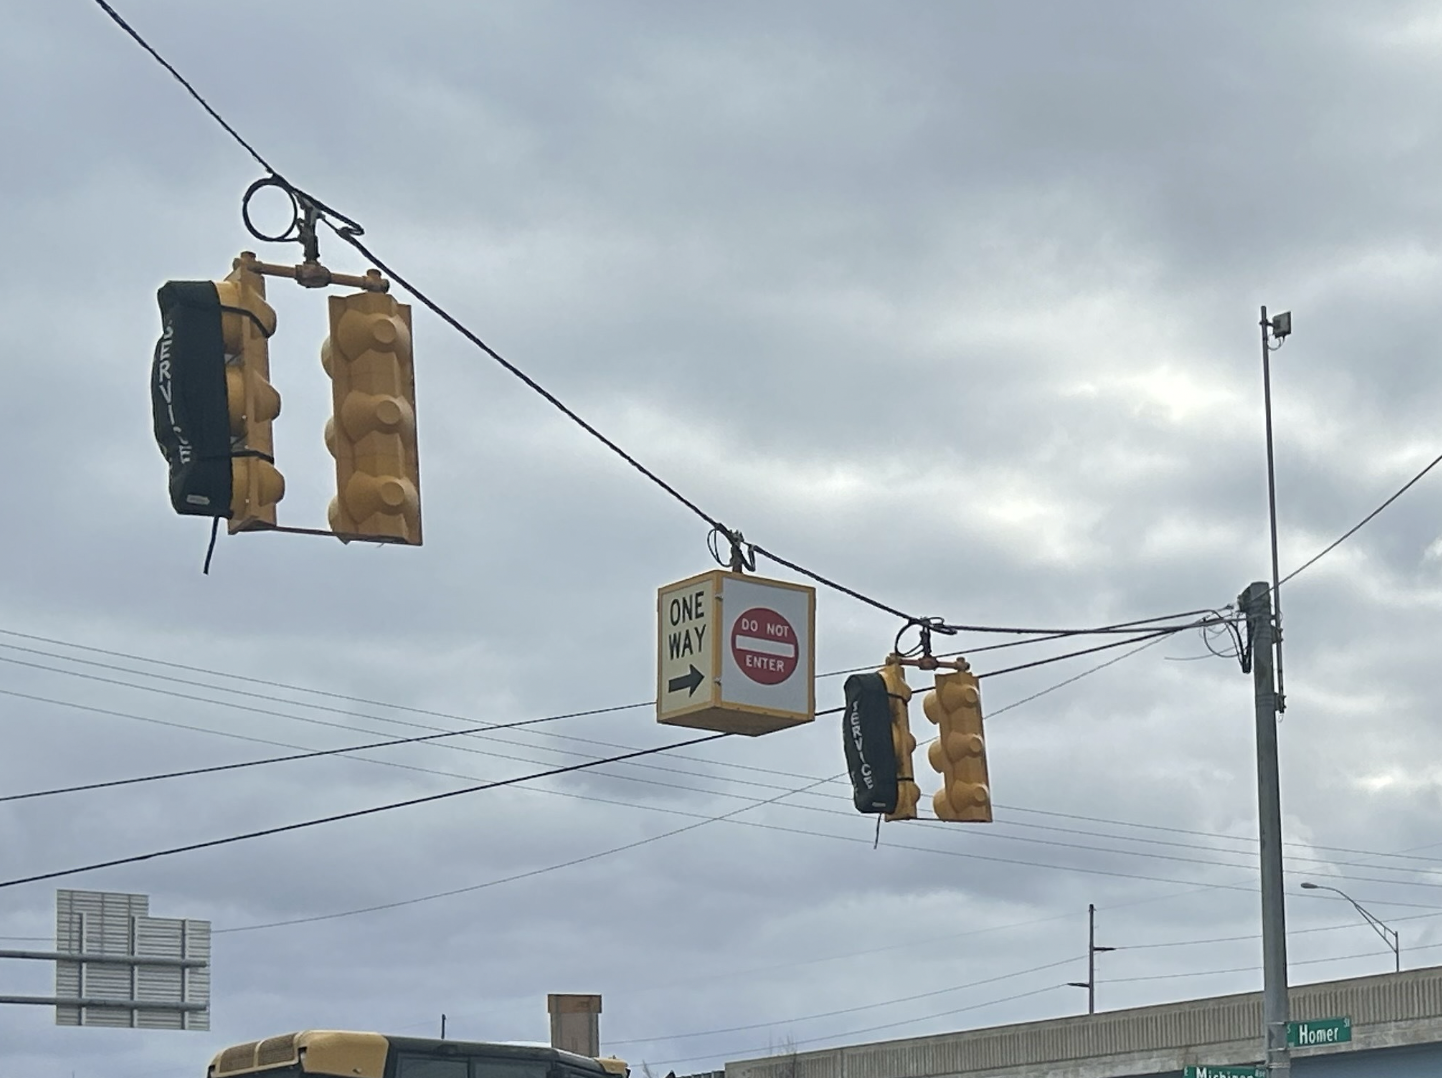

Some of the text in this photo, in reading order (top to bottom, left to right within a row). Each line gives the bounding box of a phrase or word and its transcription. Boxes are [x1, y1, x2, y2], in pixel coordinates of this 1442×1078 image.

[670, 590, 704, 626] ONE
[669, 624, 706, 660] WAY
[741, 618, 789, 638] DO NOT
[746, 655, 784, 672] ENTER
[850, 700, 874, 790] SERVICE
[1299, 1024, 1339, 1045] Homer
